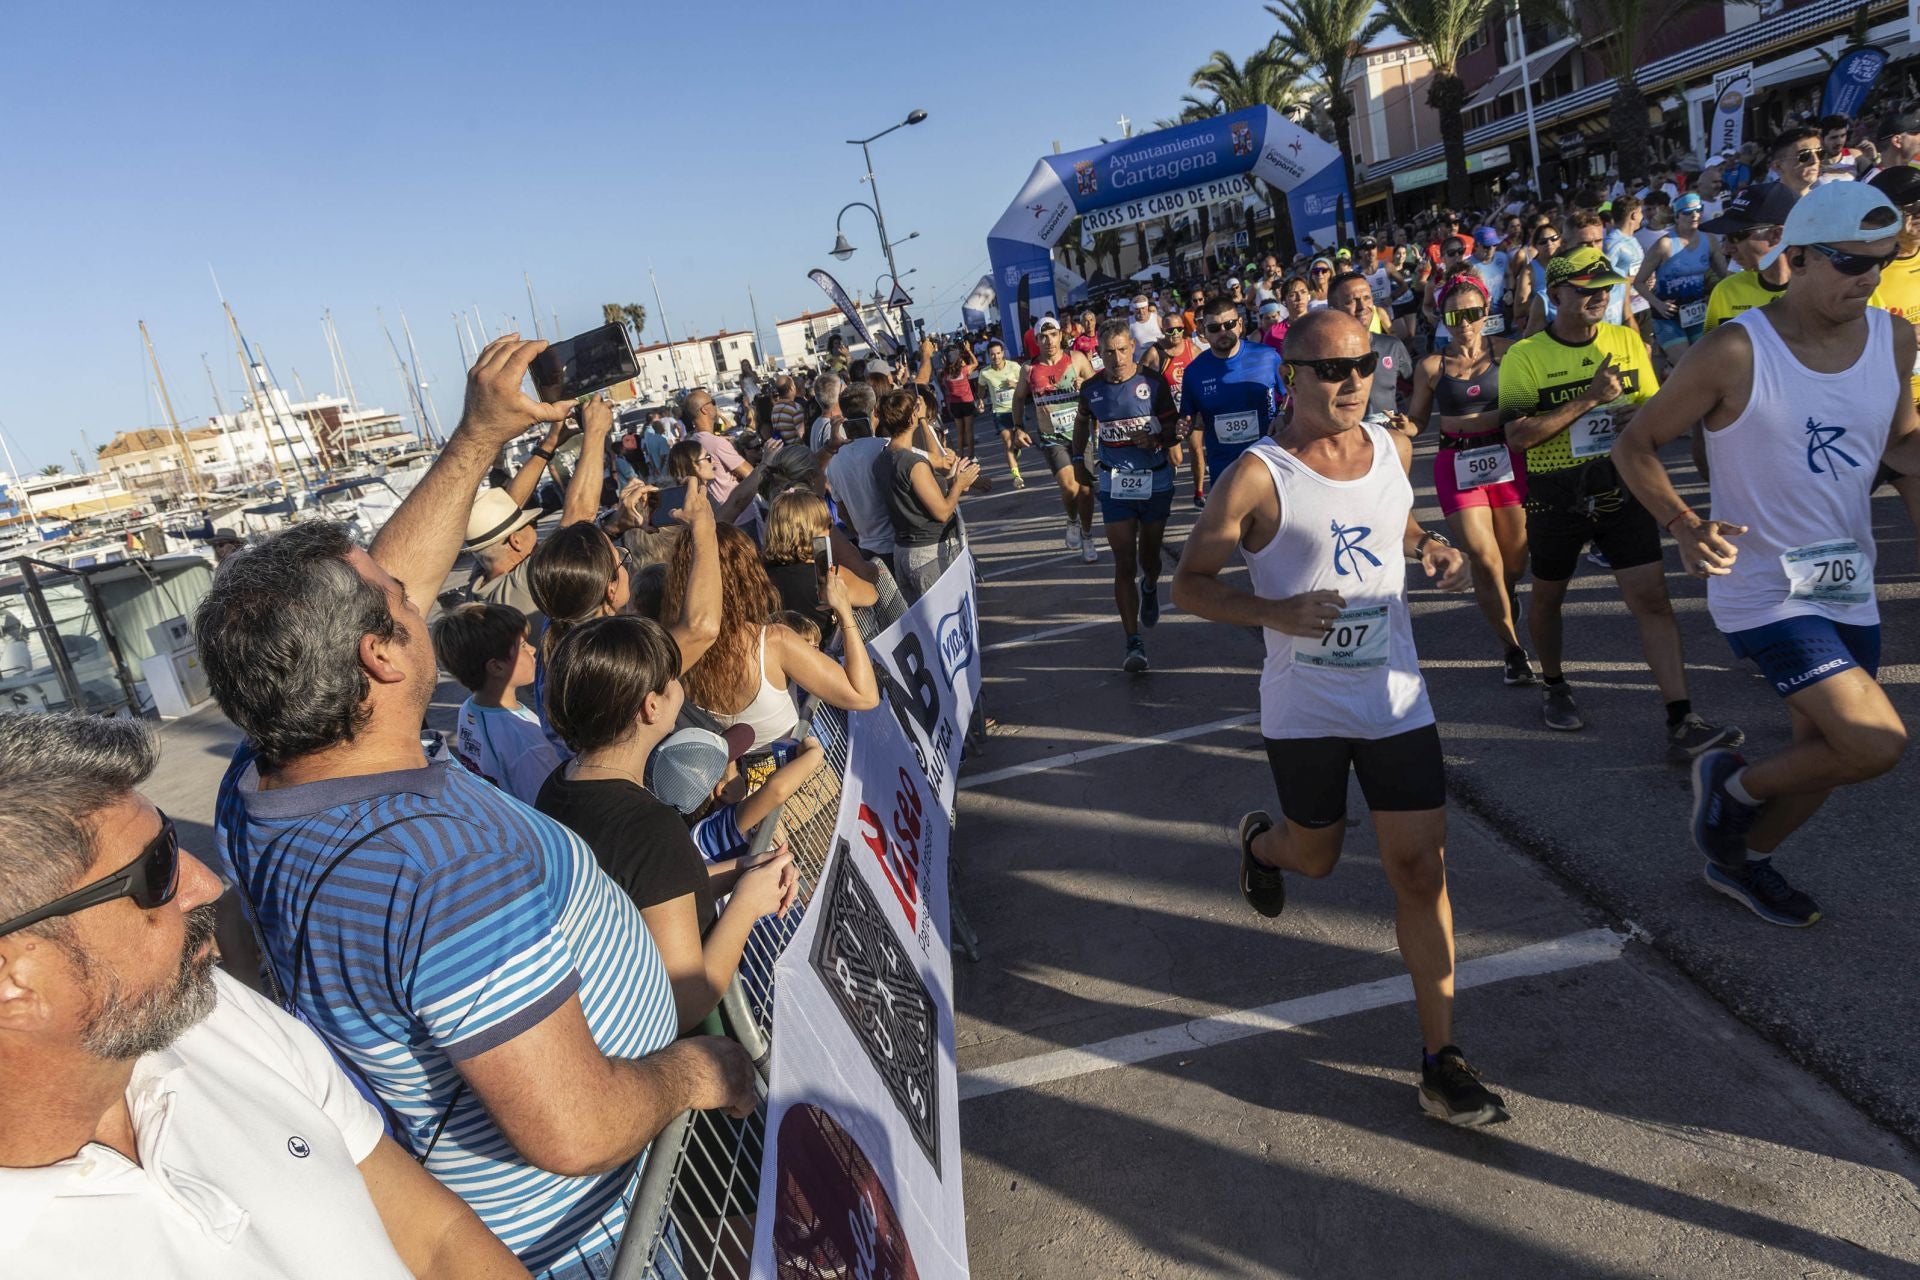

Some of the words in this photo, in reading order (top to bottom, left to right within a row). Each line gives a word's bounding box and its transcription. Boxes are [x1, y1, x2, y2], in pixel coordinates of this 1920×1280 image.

[1109, 133, 1215, 169] Ayuntamiento
[1111, 151, 1218, 188] Cartagena
[1265, 152, 1302, 178] Deportes
[1082, 207, 1124, 231] CROSS
[1127, 201, 1145, 222] DE
[1148, 193, 1184, 214] CABO
[1188, 187, 1206, 205] DE
[1210, 177, 1251, 199] PALOS
[1041, 205, 1068, 240] Deportes
[1547, 370, 1569, 379] FASTER
[1225, 420, 1248, 432] 389
[1469, 457, 1498, 473] 508
[1121, 478, 1143, 488] 624
[1813, 559, 1856, 582] 706
[1320, 625, 1369, 648] 707
[1789, 658, 1849, 686] LURBEL
[927, 716, 954, 806] NAUTICA
[857, 766, 923, 934] Paseo
